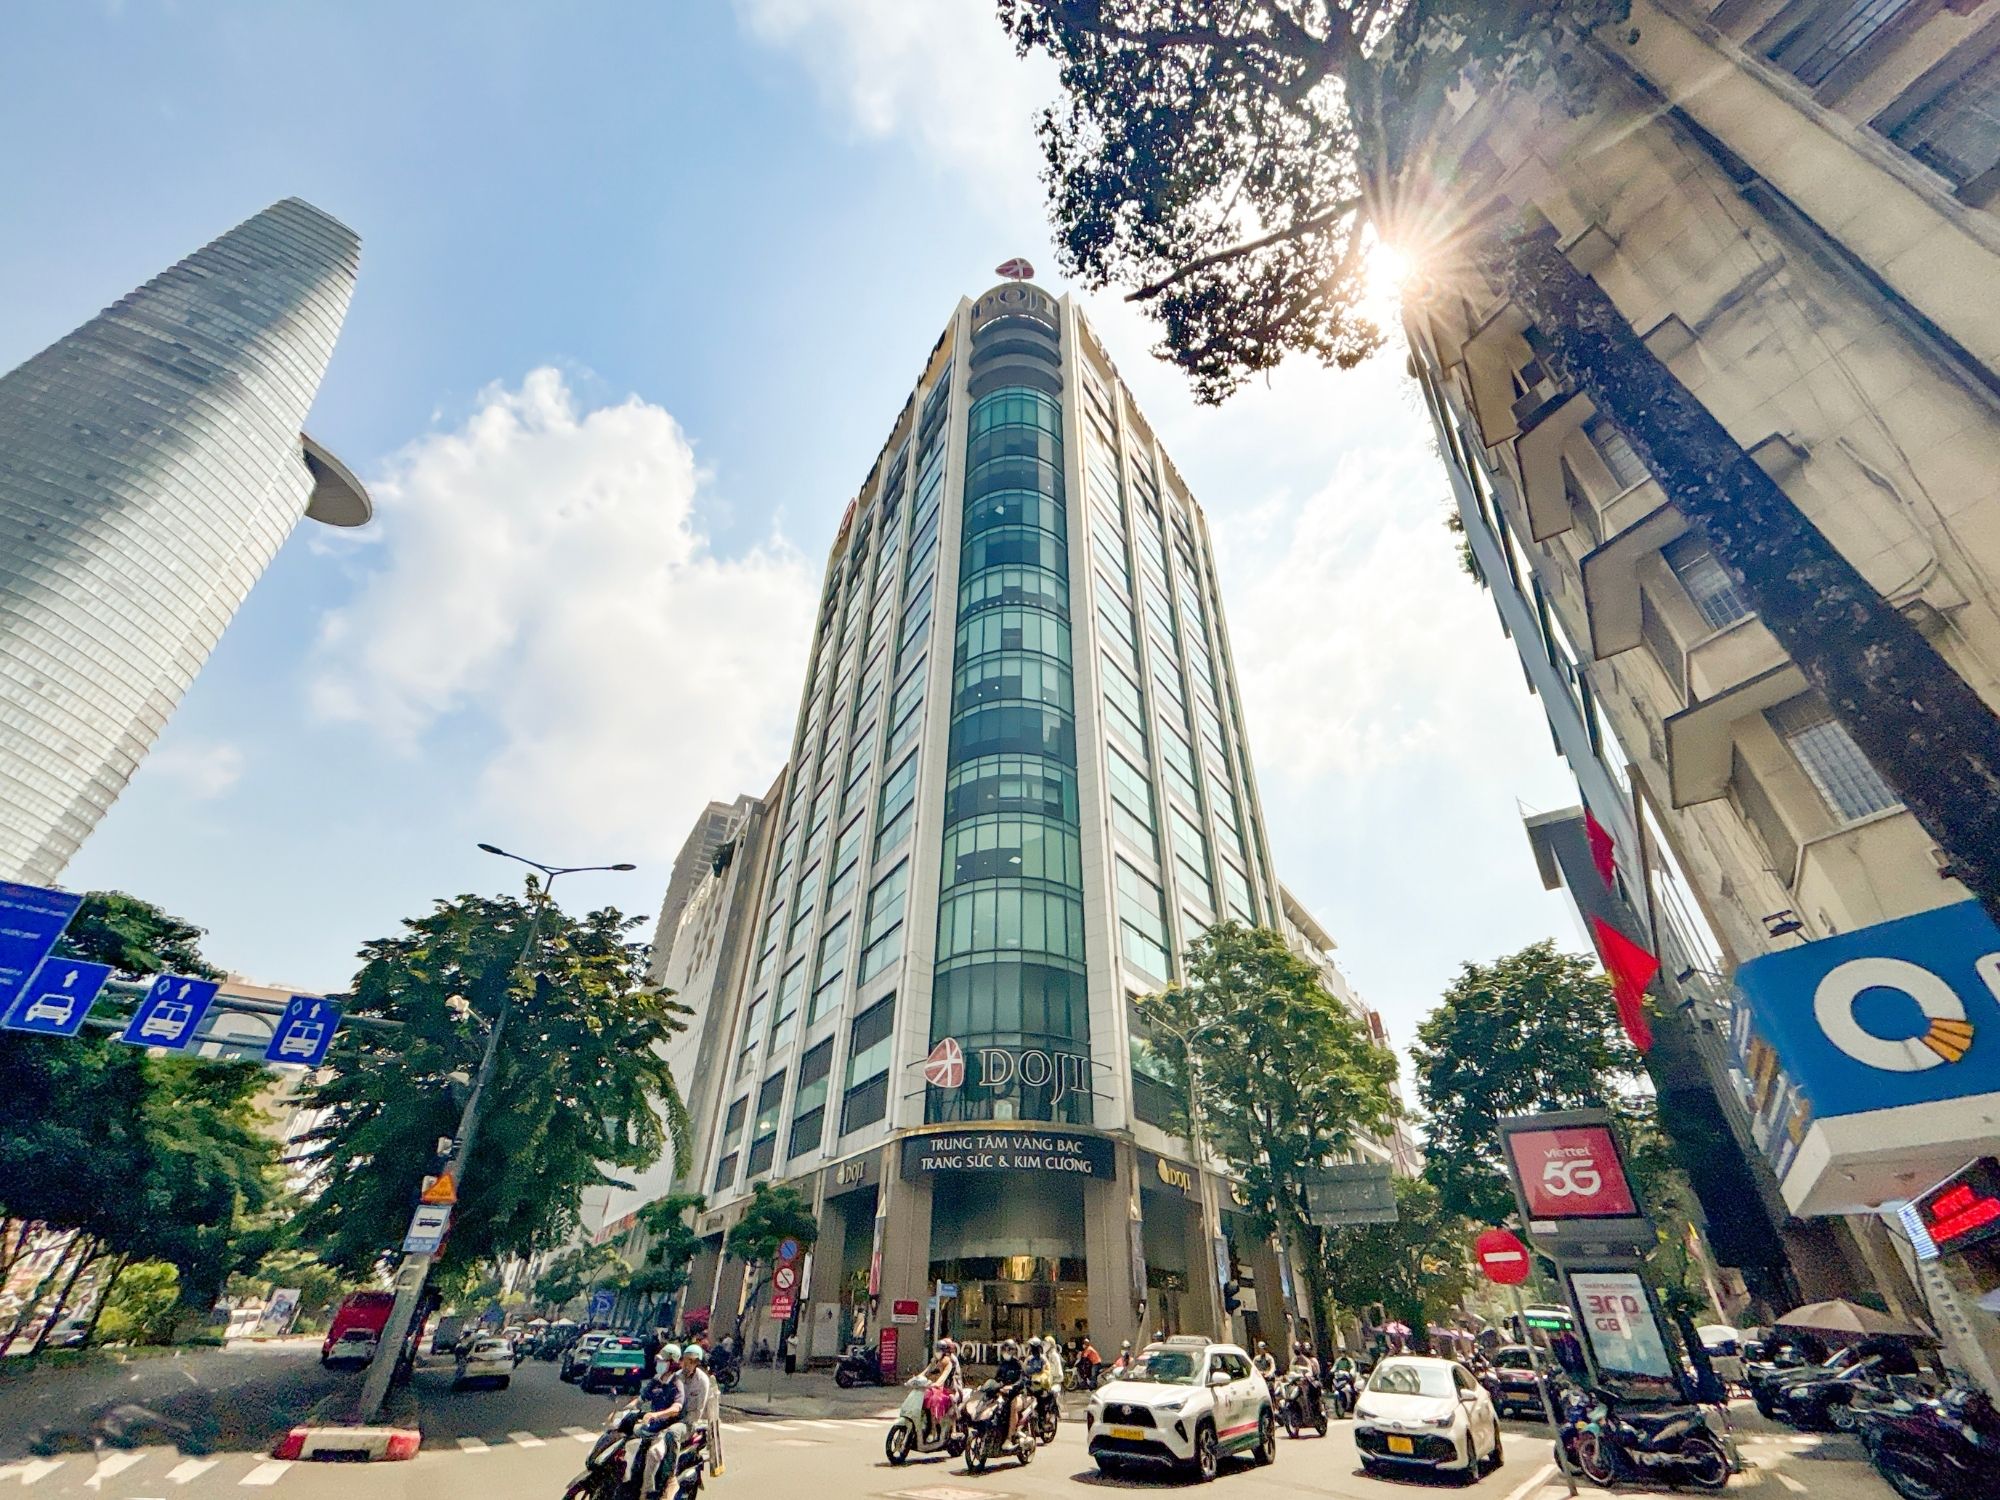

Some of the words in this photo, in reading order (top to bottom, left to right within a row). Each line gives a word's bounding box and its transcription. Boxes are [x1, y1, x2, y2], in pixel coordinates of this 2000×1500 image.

[979, 1048, 1090, 1105] DOJI
[930, 1137, 973, 1151] TRUNG
[977, 1135, 1008, 1149] TÂM
[1013, 1135, 1053, 1151] VÀNG
[1057, 1140, 1084, 1155] BẠC
[845, 1161, 864, 1186] DOJI
[921, 1156, 963, 1170] TRANG
[967, 1152, 993, 1168] SỨC
[998, 1154, 1010, 1167] &
[1014, 1155, 1041, 1169] KIM
[1045, 1156, 1092, 1174] CƯƠNG
[1169, 1168, 1191, 1195] DOJI
[1543, 1159, 1601, 1197] 5G
[1595, 1317, 1622, 1332] GB
